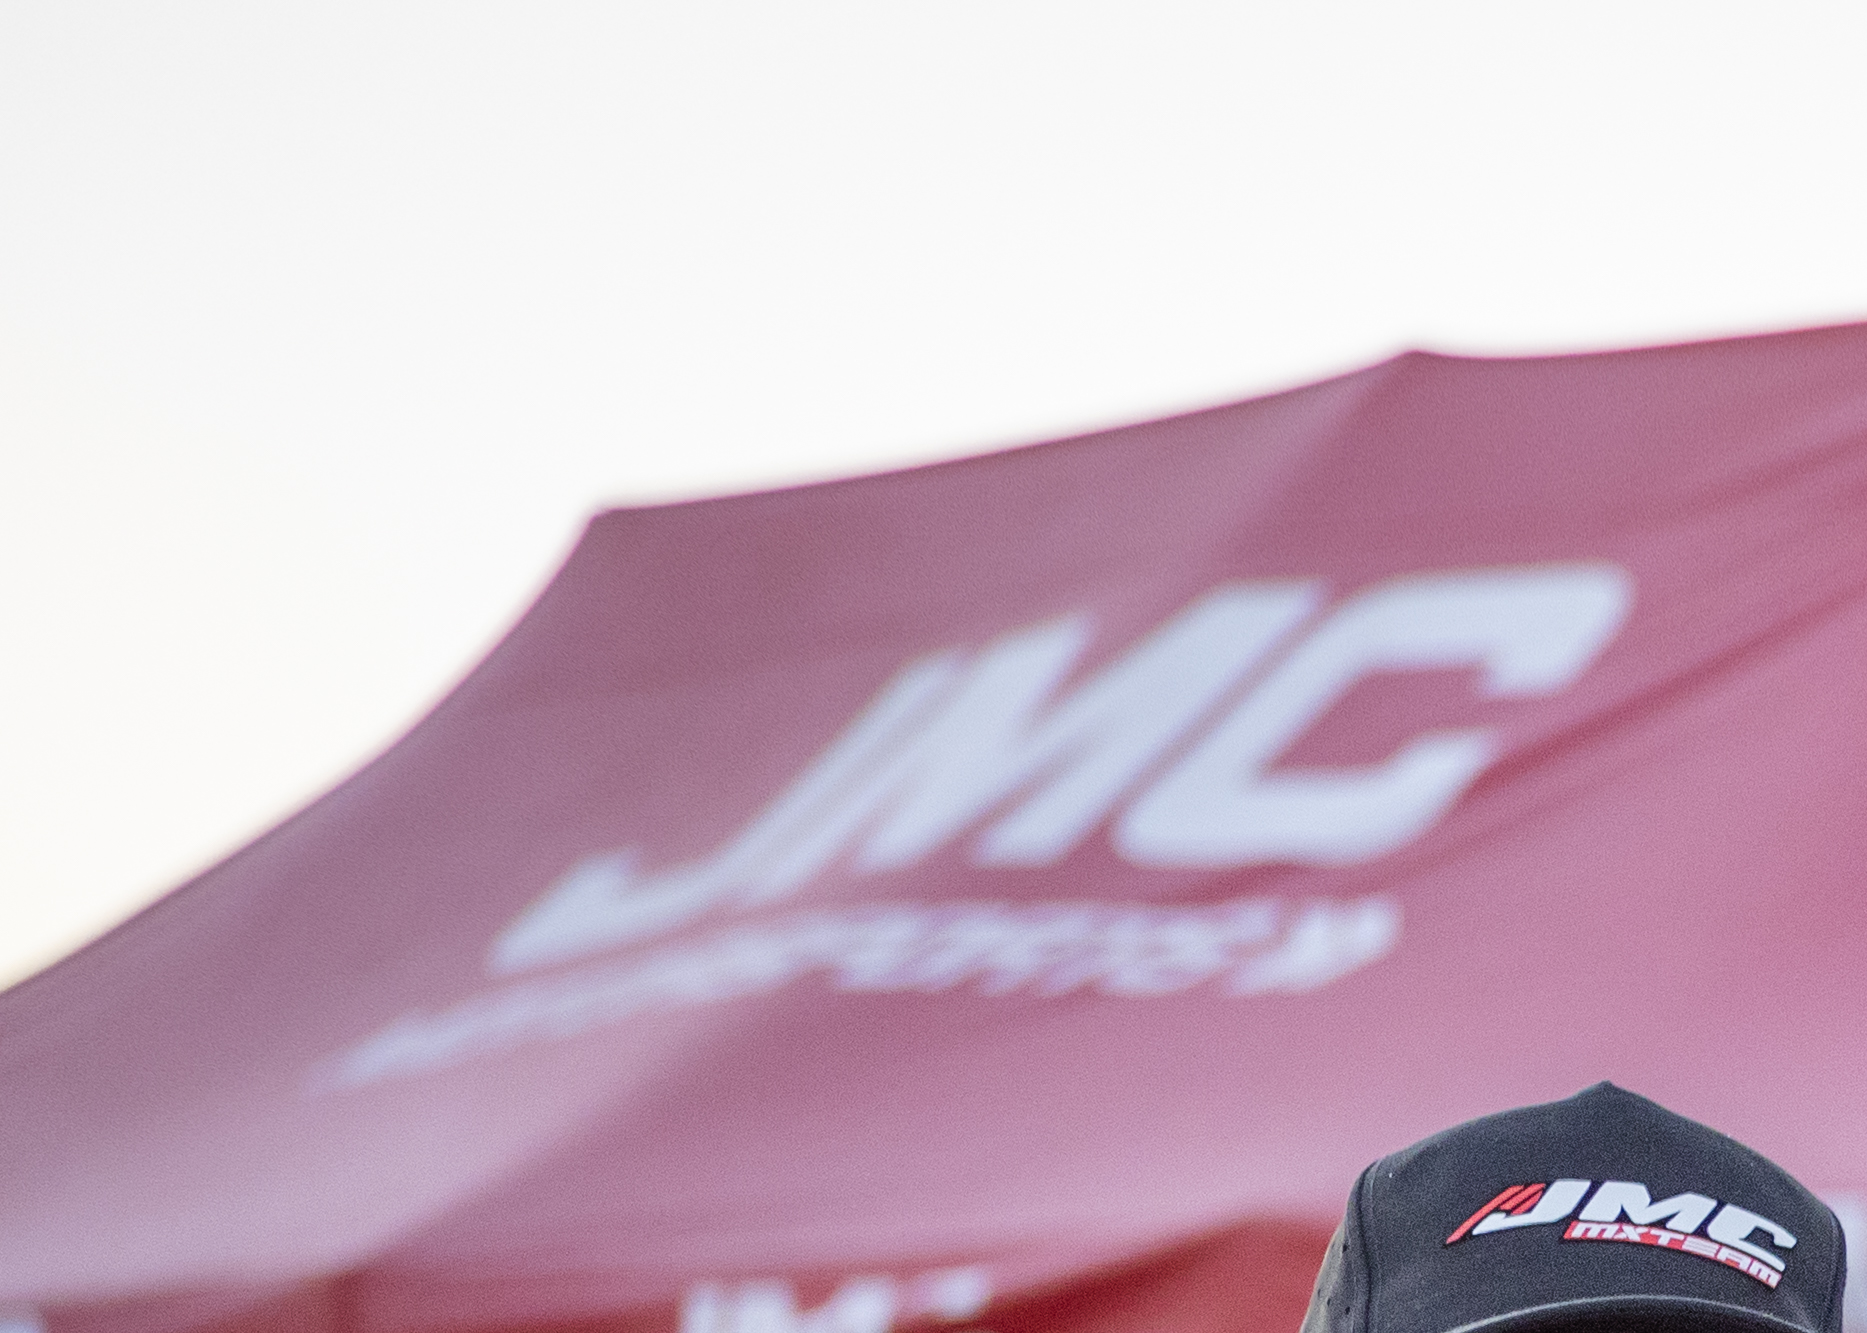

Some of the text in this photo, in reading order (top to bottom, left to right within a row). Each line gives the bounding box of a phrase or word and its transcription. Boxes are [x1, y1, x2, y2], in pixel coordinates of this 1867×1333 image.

[490, 563, 1633, 979] JMC
[1472, 1178, 1798, 1272] JMC
[1568, 1221, 1781, 1286] MXTEAM
